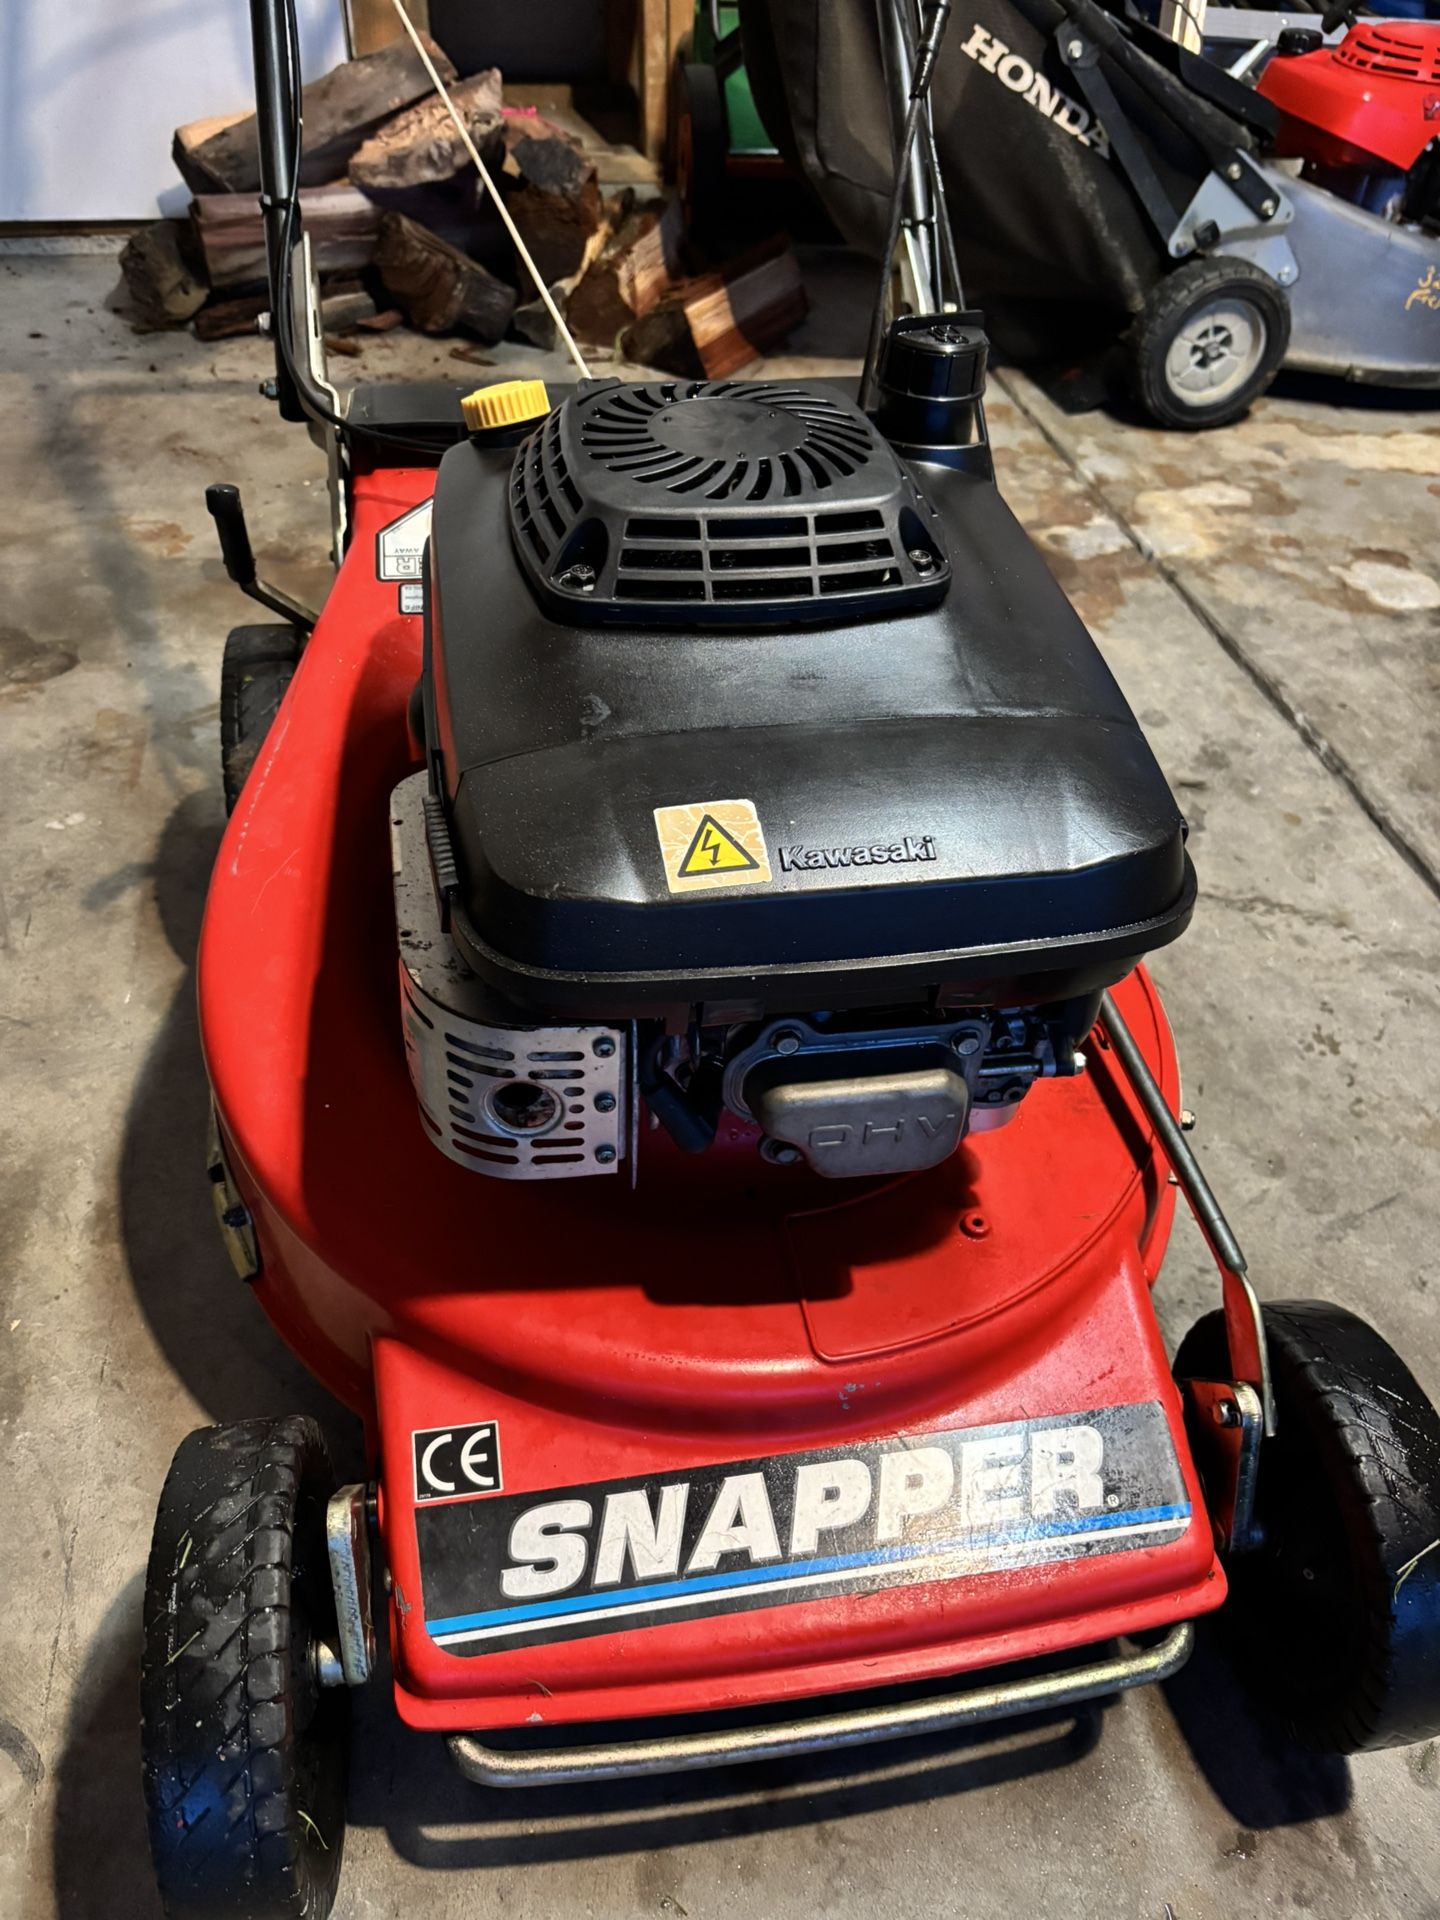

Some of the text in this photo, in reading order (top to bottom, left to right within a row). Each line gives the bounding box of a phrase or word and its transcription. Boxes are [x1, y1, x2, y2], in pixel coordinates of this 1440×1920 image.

[960, 24, 1110, 160] HONDA
[778, 836, 937, 872] Kawasaki
[808, 1114, 955, 1148] OHV
[421, 1428, 495, 1491] CE
[499, 1424, 1106, 1600] SNAPPER
